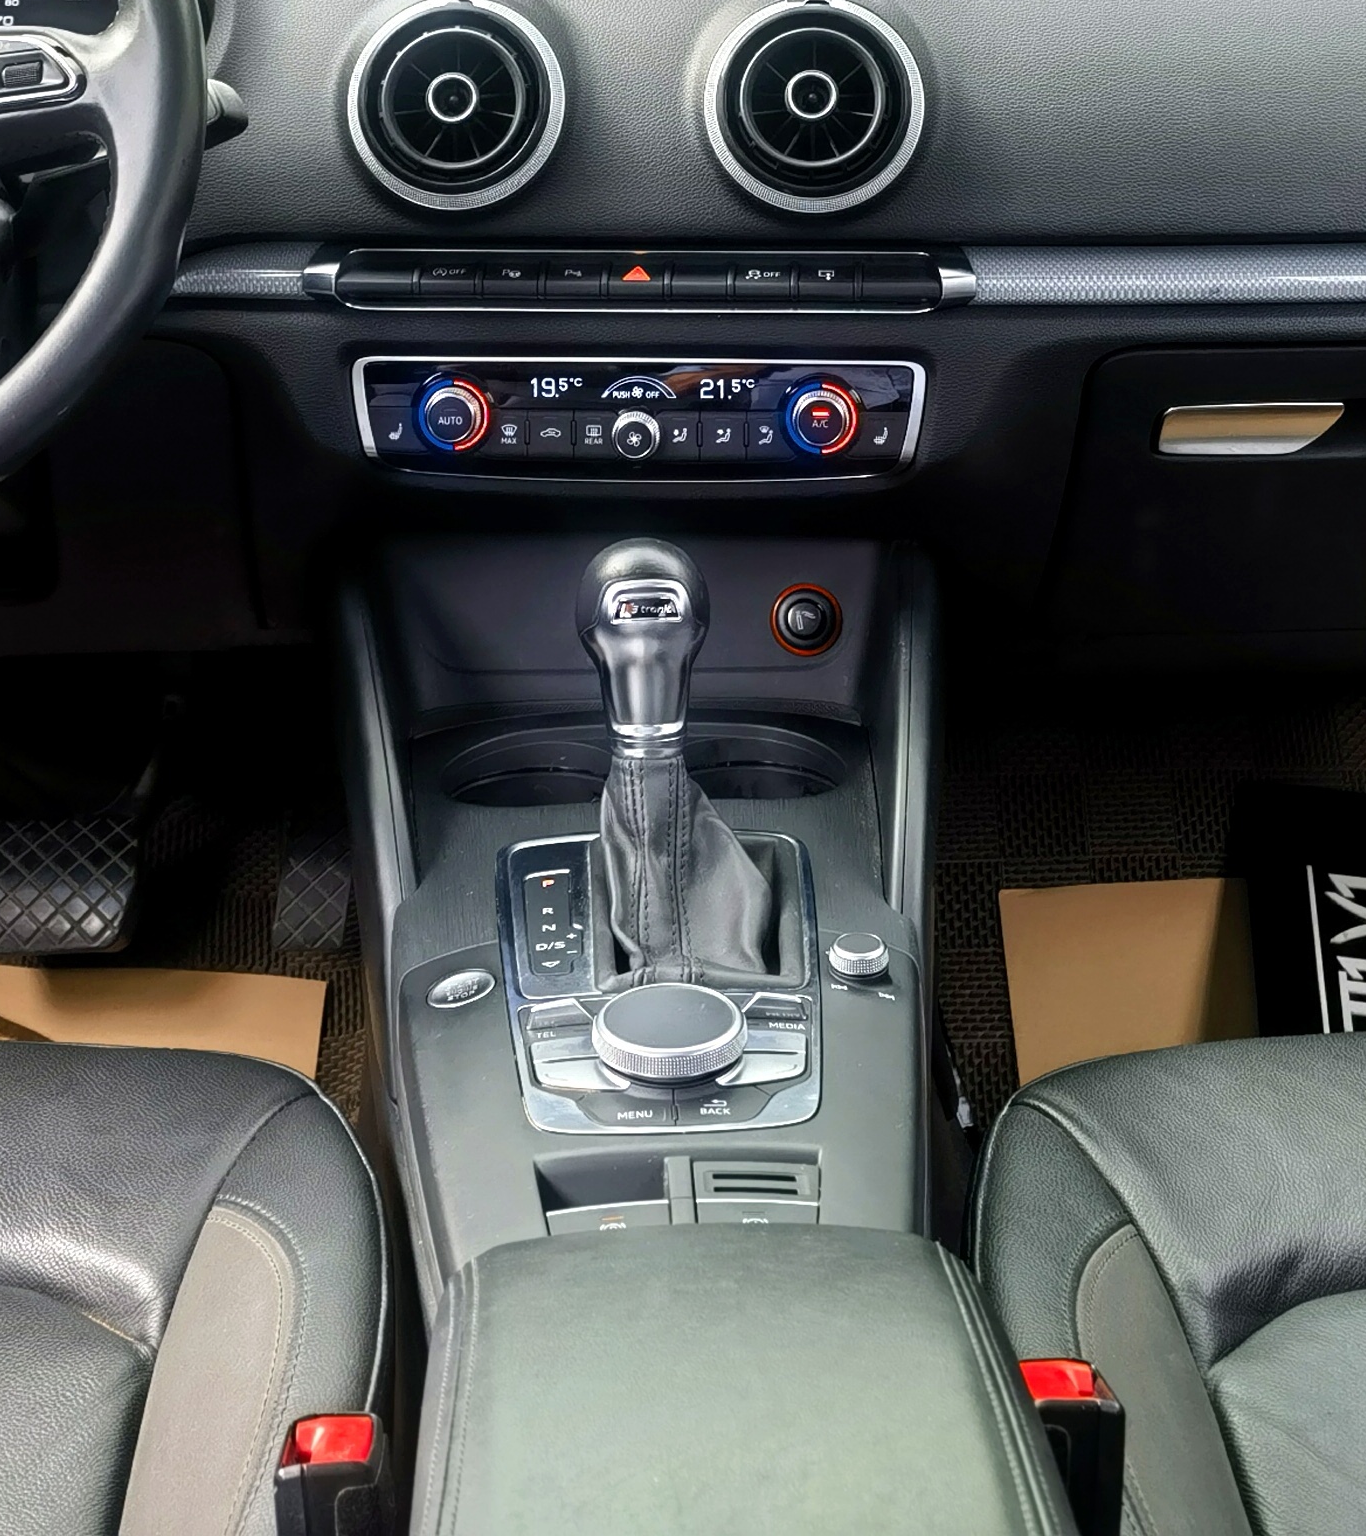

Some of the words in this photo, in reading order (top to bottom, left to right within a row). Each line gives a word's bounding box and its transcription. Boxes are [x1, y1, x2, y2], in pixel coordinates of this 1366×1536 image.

[612, 390, 631, 399] PUSH
[645, 390, 661, 399] OFF
[437, 415, 464, 426] AUTO
[811, 419, 829, 429] A/C
[500, 437, 517, 445] MAX
[542, 878, 555, 888] P
[542, 907, 554, 915] R
[542, 923, 556, 932] N
[535, 941, 566, 951] D/S
[447, 990, 476, 1002] STOP
[768, 1021, 806, 1031] MEDIA
[536, 1031, 557, 1039] TEL
[616, 1109, 653, 1121] MENU
[699, 1107, 731, 1116] BACK
